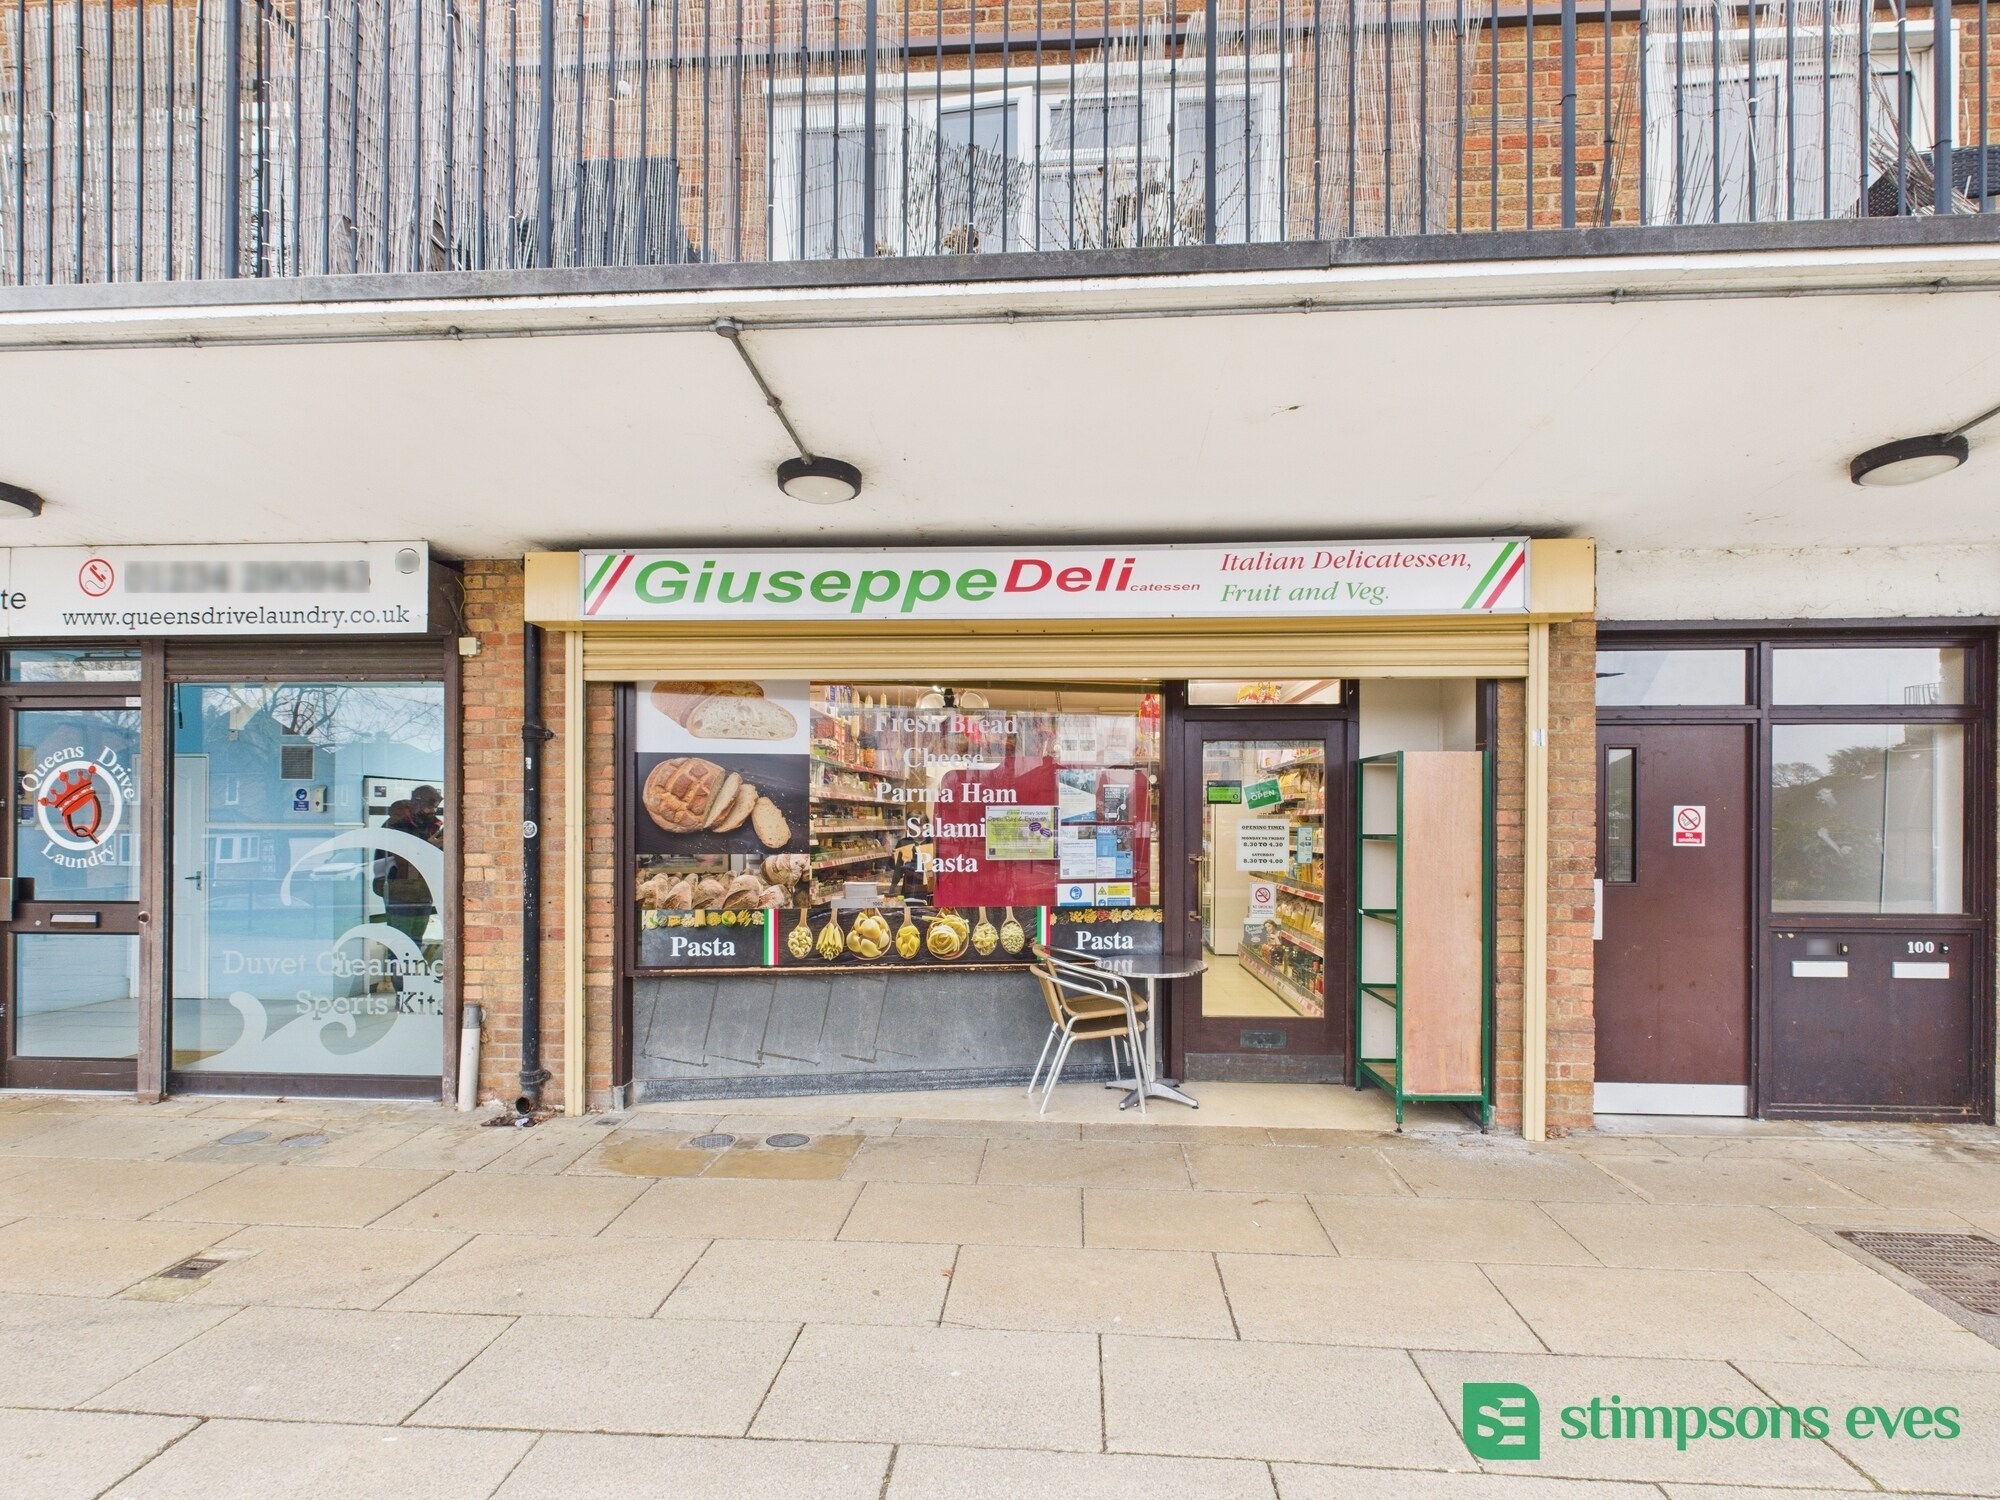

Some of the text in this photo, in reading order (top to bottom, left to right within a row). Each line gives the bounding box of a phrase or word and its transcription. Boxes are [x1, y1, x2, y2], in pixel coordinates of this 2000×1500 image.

[1220, 549, 1473, 572] Italian Delicatessen,
[634, 559, 998, 614] Giuseppe
[1219, 582, 1389, 607] Fruit and Veg.
[62, 605, 410, 630] www.queensdrivelaundry.co.uk
[874, 711, 1019, 734] Fresh Bread
[903, 747, 984, 768] Cheese
[21, 745, 135, 800] Queens Drive
[876, 782, 1018, 803] Parma Ham
[1250, 789, 1275, 801] OPEN
[906, 817, 985, 838] Salami
[41, 841, 114, 869] Laundry
[915, 851, 978, 873] Pasta
[670, 936, 736, 957] Pasta
[1075, 931, 1134, 950] Pasta
[1907, 941, 1935, 953] 100
[222, 951, 443, 983] Duvet Cleaning
[295, 990, 389, 1020] Sports
